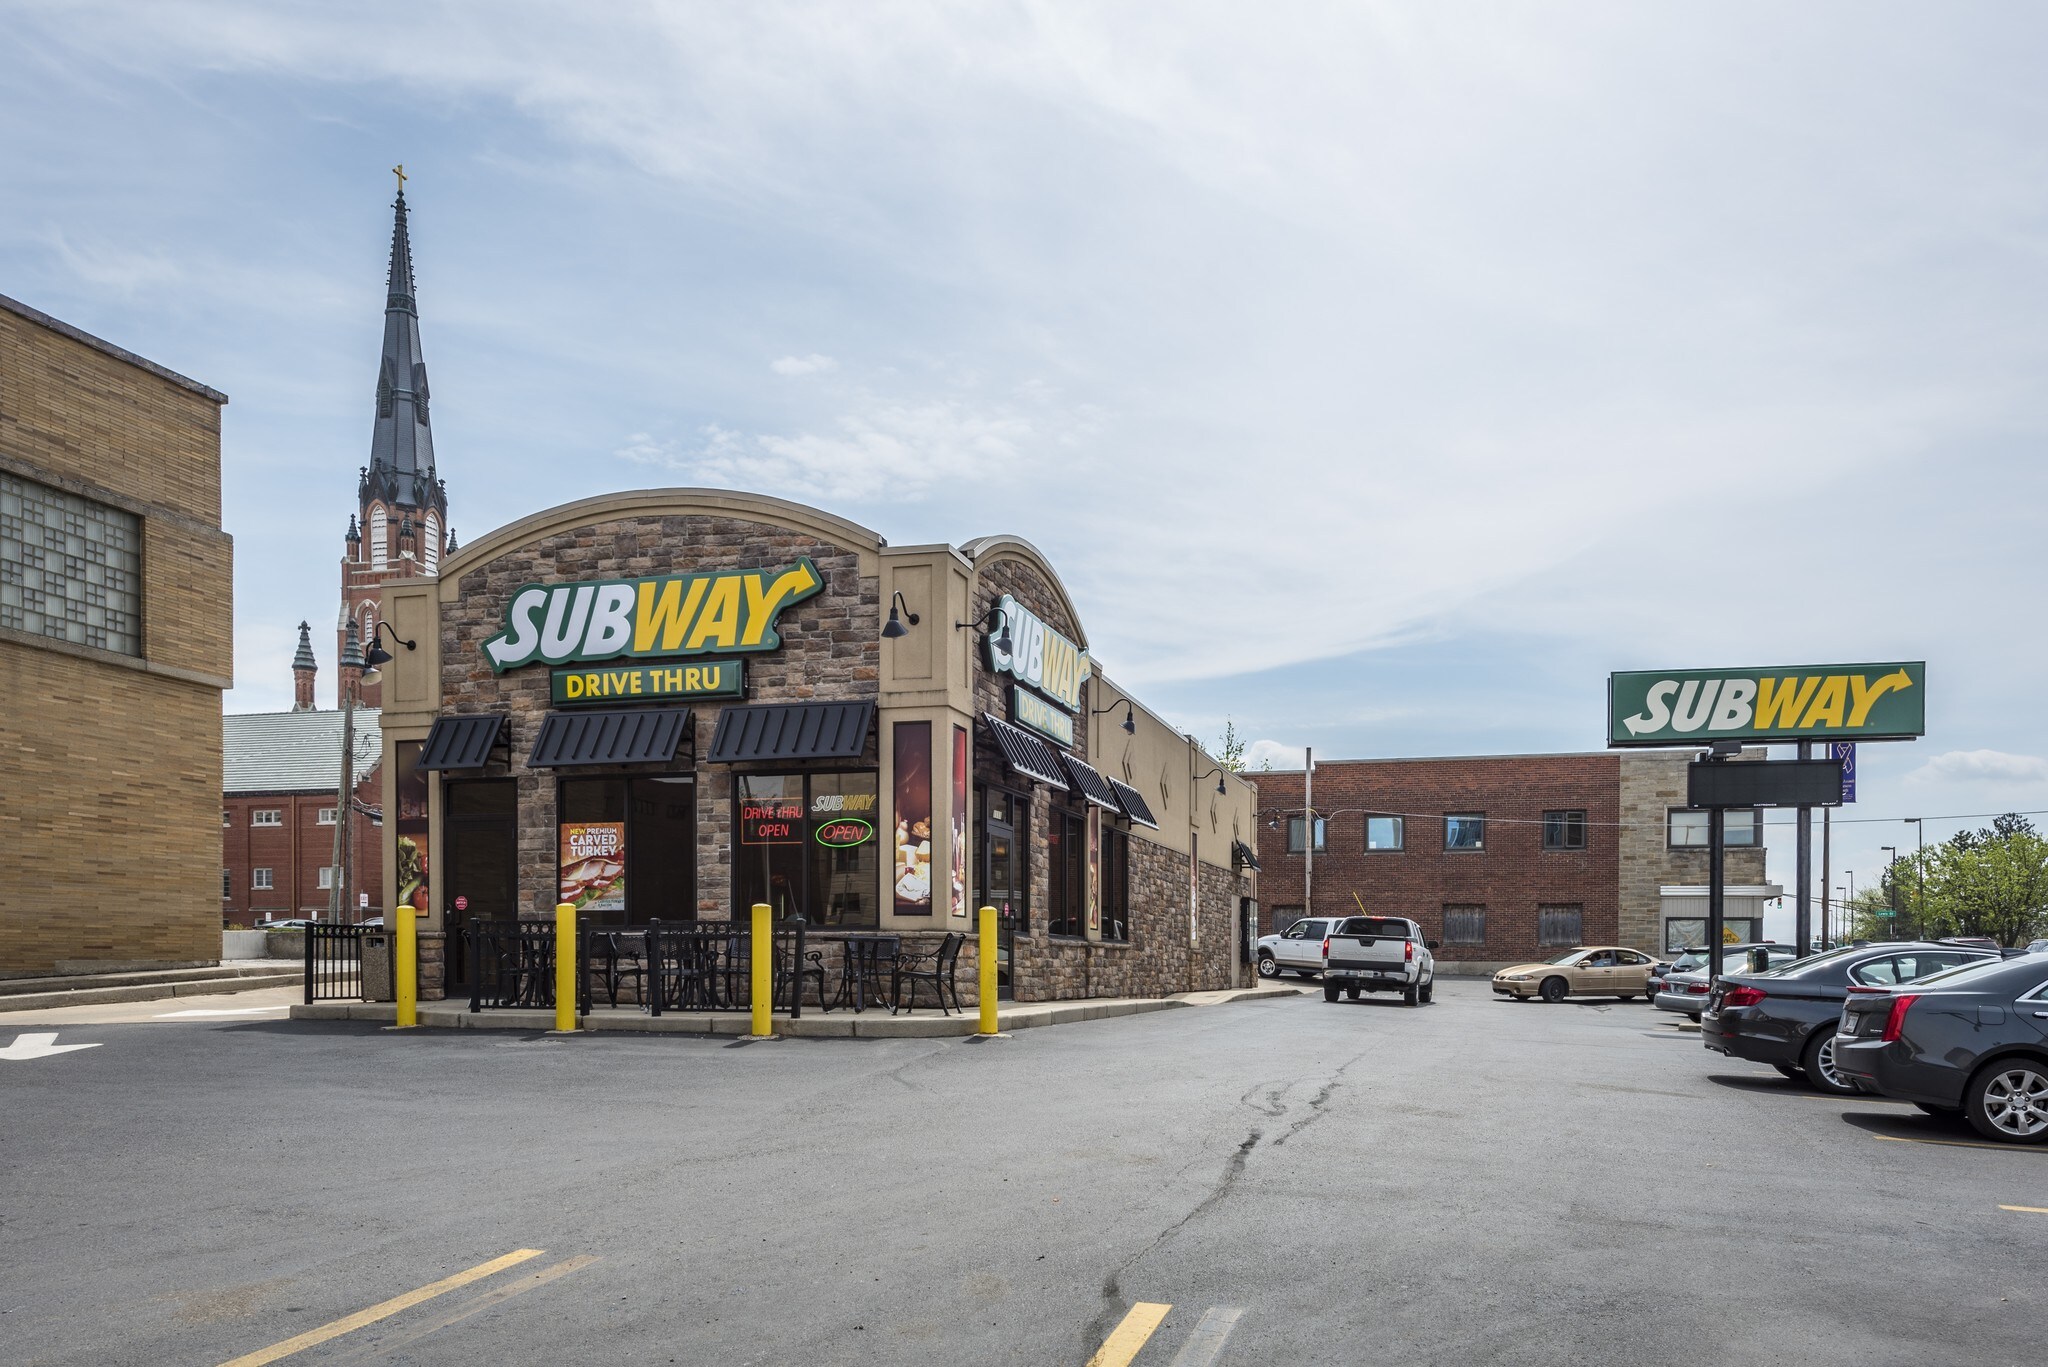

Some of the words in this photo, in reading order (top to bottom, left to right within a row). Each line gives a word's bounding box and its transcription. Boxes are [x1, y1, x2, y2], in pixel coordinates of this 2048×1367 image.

[486, 562, 815, 667] SUBWAY
[991, 601, 1090, 707] SUBWAY
[566, 671, 642, 698] DRIVE
[649, 667, 720, 692] THRU
[1623, 667, 1913, 737] SUBWAY
[1021, 694, 1049, 729] DRIVE
[1050, 713, 1071, 742] THRU
[811, 794, 877, 812] SUBWAY
[744, 806, 774, 820] DRIVE
[776, 805, 803, 819] THRU
[586, 827, 618, 835] PREMIUM
[758, 824, 789, 837] OPEN
[823, 825, 864, 840] OPEN
[569, 834, 617, 846] CARVED
[570, 845, 617, 857] TURKEY
